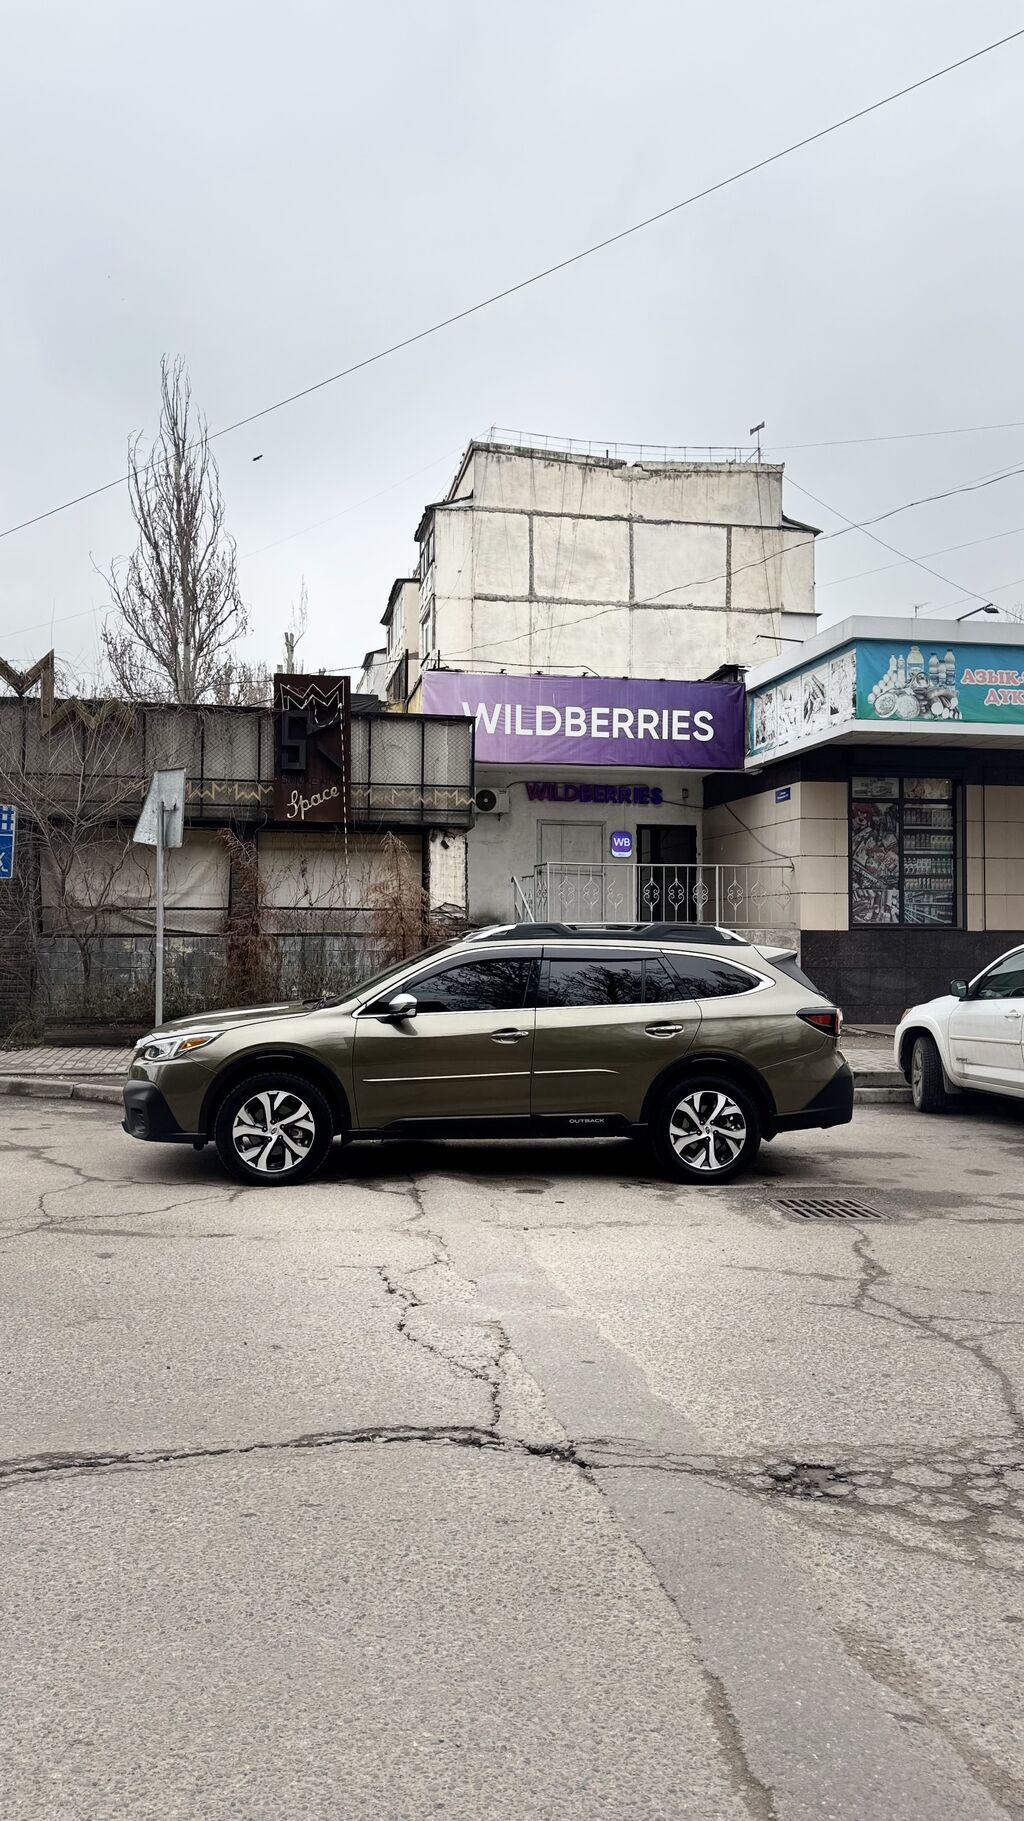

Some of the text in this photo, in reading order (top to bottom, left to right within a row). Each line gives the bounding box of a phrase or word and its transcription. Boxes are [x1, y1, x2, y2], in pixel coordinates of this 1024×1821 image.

[960, 668, 1024, 687] АЗЫК-
[462, 702, 714, 741] WILDBERRIES
[286, 786, 339, 820] Space
[525, 783, 663, 804] WILDBERRIES
[613, 837, 631, 847] WB
